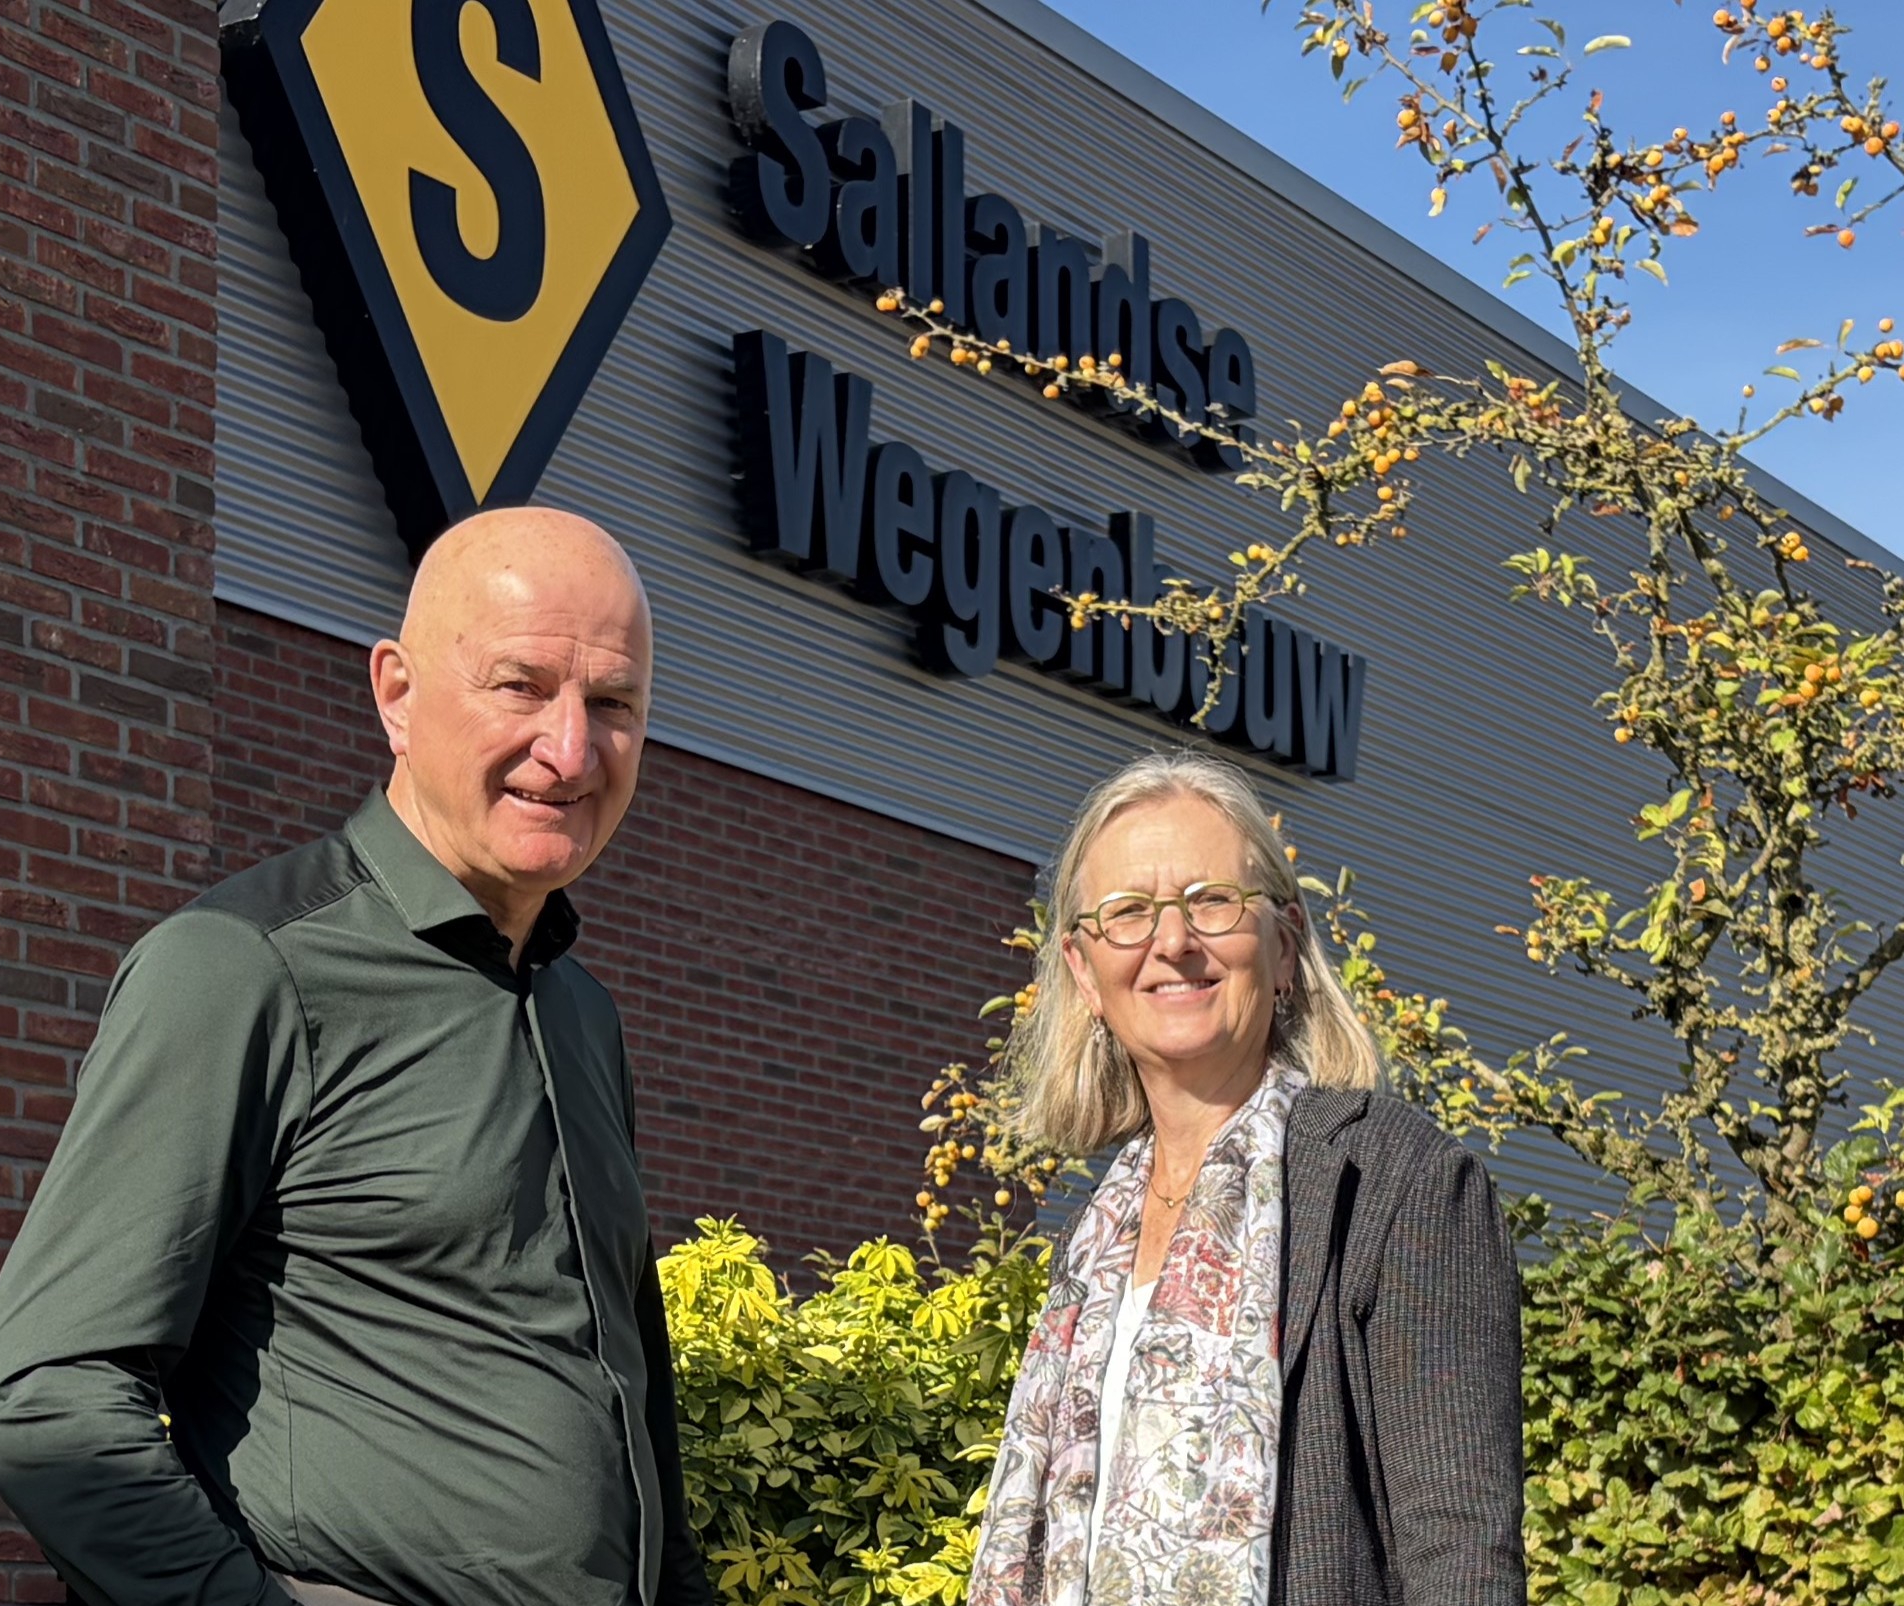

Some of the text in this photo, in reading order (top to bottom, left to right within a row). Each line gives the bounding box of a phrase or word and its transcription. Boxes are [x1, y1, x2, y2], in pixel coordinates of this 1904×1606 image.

[408, 0, 545, 322] S
[732, 20, 1256, 470] Sallandse
[736, 329, 1366, 781] Wegenbouw
